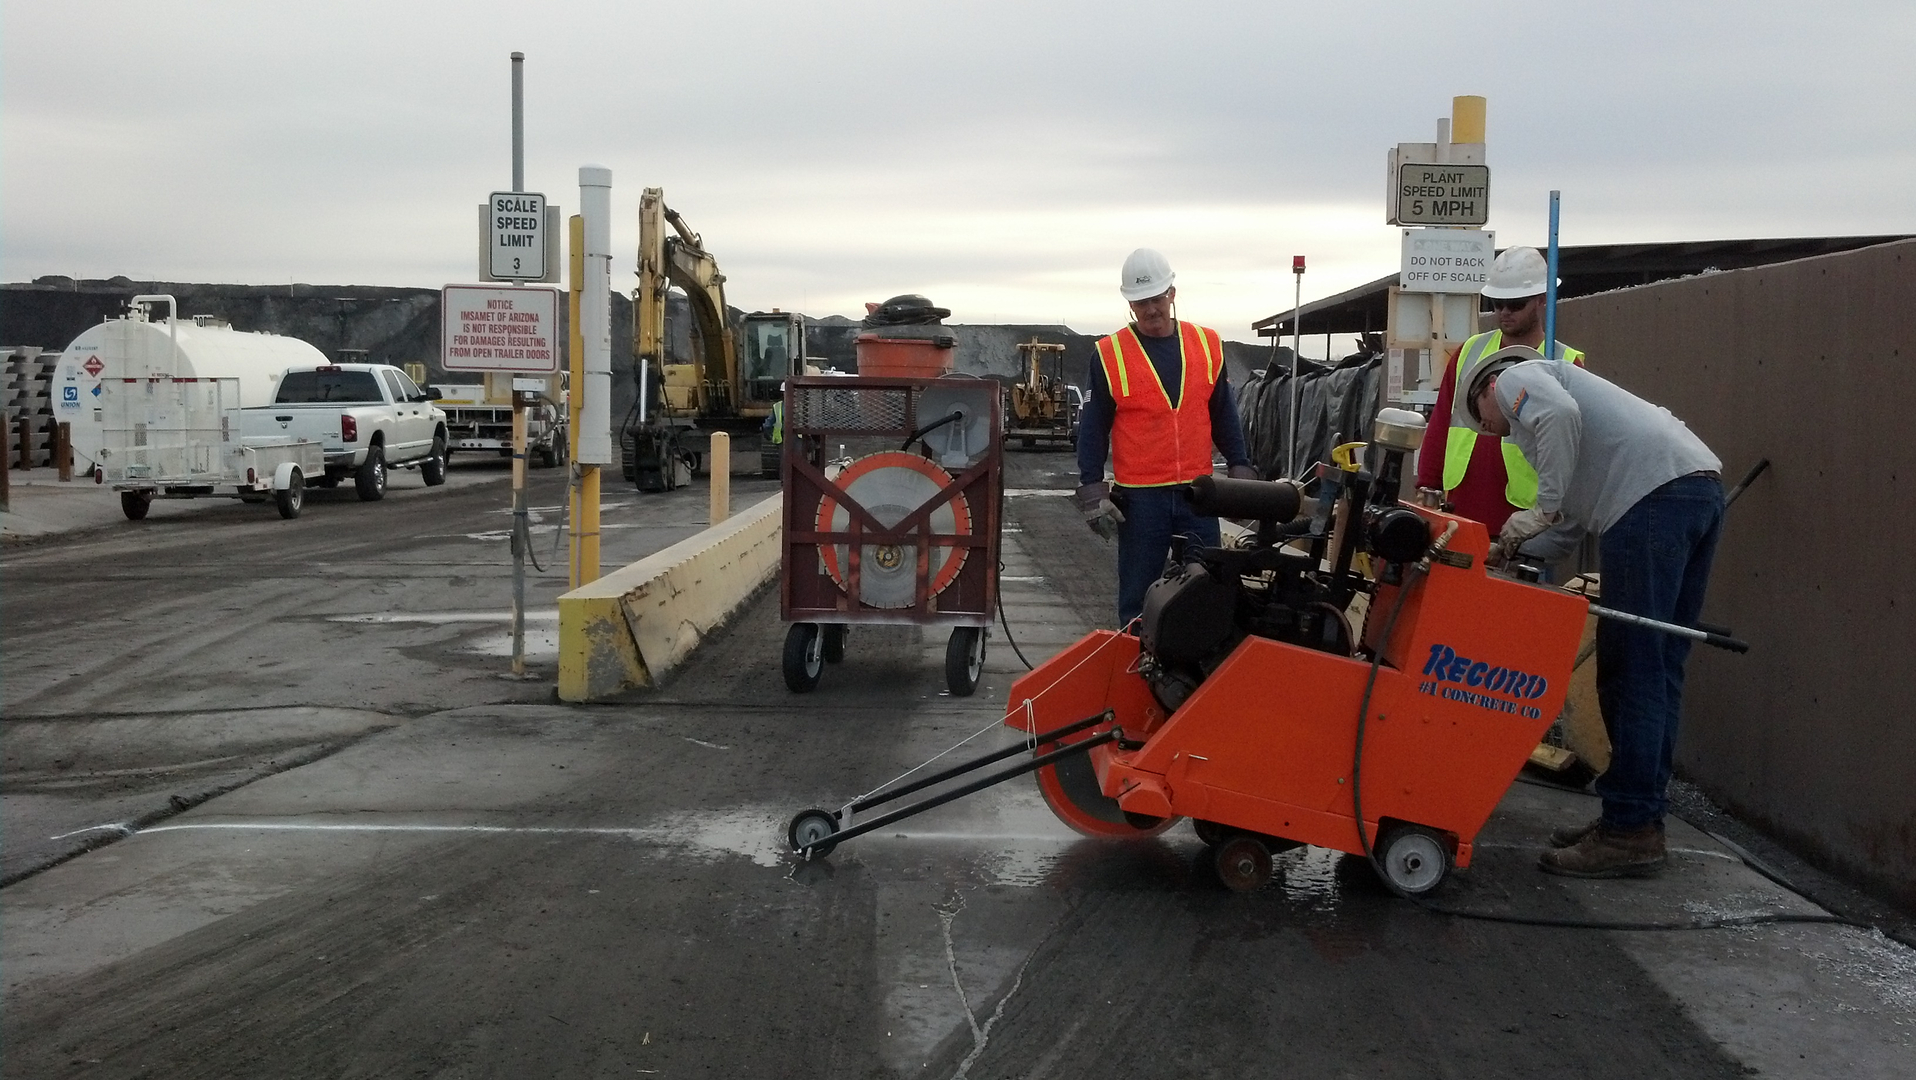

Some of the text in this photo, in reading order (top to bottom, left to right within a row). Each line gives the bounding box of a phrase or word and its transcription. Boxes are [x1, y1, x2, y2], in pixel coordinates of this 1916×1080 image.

[1423, 172, 1464, 183] PLANT
[1403, 185, 1484, 198] SPEED LIMIT
[497, 199, 537, 213] SCALE
[1412, 200, 1474, 216] 5 MPH
[497, 216, 537, 230] SPEED
[500, 234, 534, 247] LIMIT
[513, 257, 520, 270] 3
[1411, 257, 1485, 267] DO NOT BACK
[1408, 272, 1486, 282] OFF OF SCALE
[487, 300, 513, 310] NOTICE
[461, 311, 540, 323] IMSAMET OF ARIZONA
[463, 324, 537, 335] IS NOT RESPONSIBLE
[454, 335, 546, 347] FOR DAMAGES RESULTING
[450, 348, 550, 360] FROM OPEN TRAILER DOORS
[1422, 644, 1548, 699] RECORD
[1419, 681, 1541, 719] #1 CONCRETE CO
